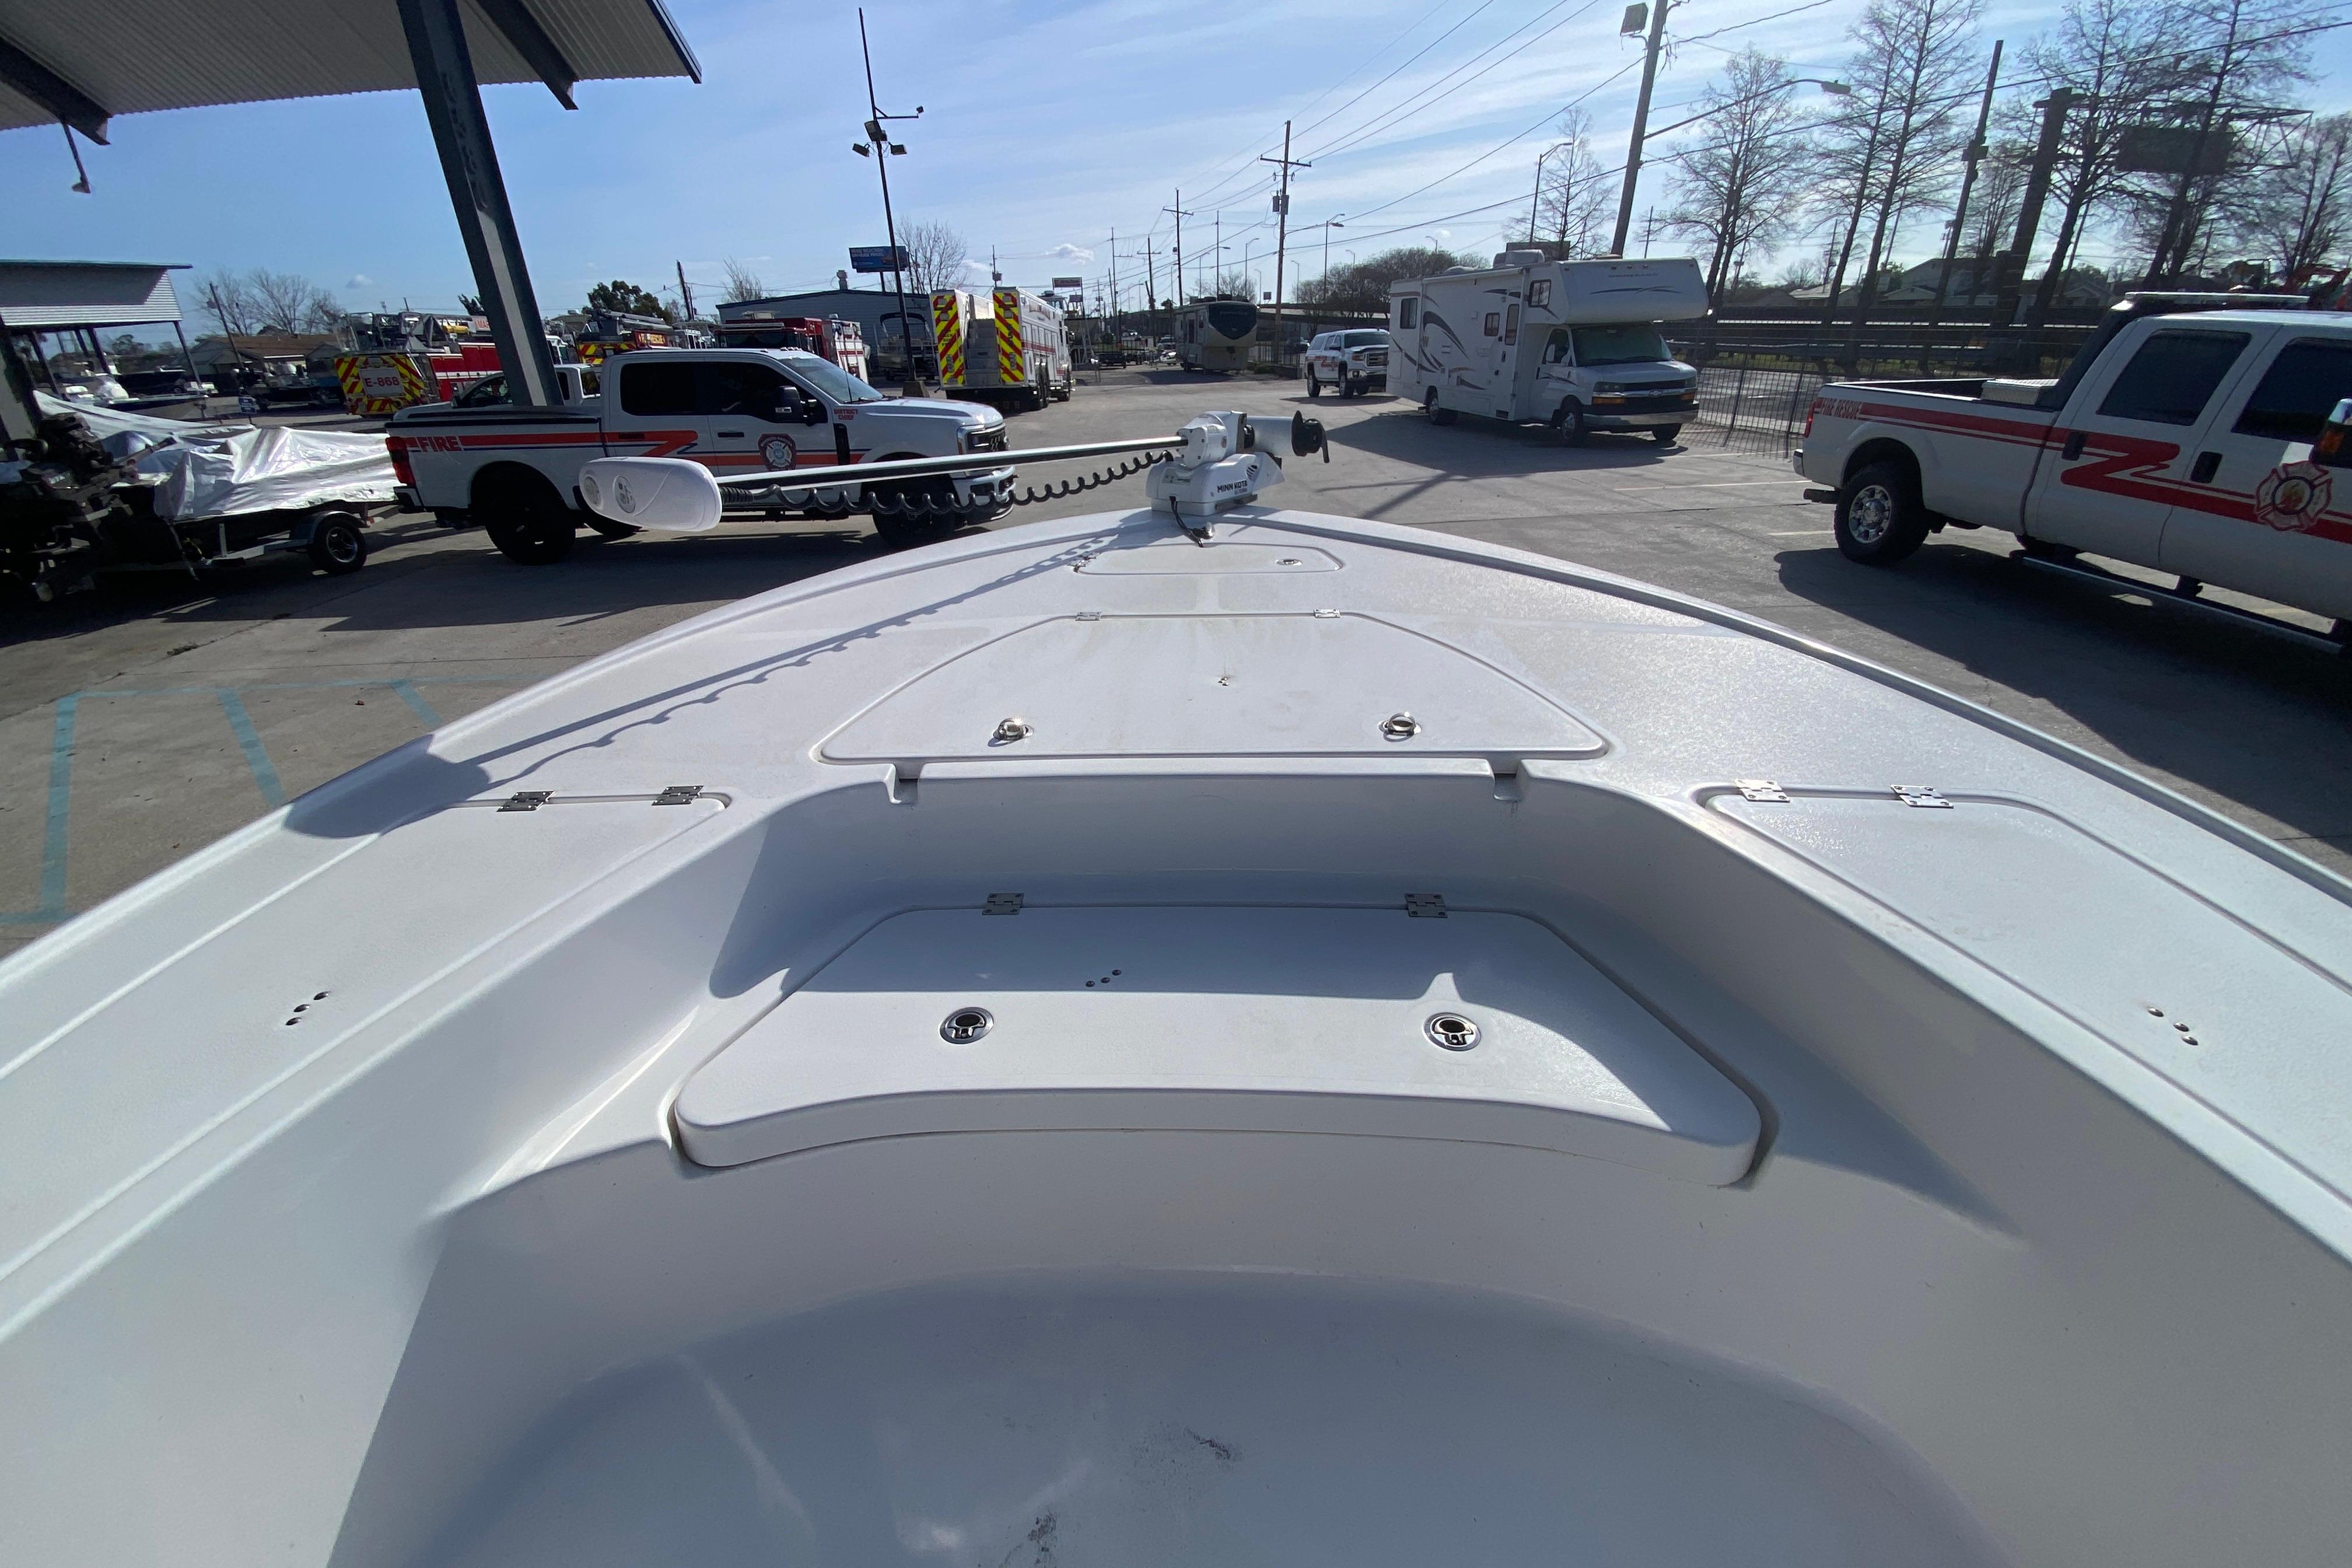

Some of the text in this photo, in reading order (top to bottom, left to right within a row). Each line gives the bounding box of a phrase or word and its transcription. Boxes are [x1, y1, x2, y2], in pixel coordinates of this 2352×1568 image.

[364, 376, 400, 387] E-868
[1820, 397, 1863, 419] FIRE RESCUE
[416, 436, 462, 452] FIRE
[1217, 480, 1248, 494] MINN KOTA
